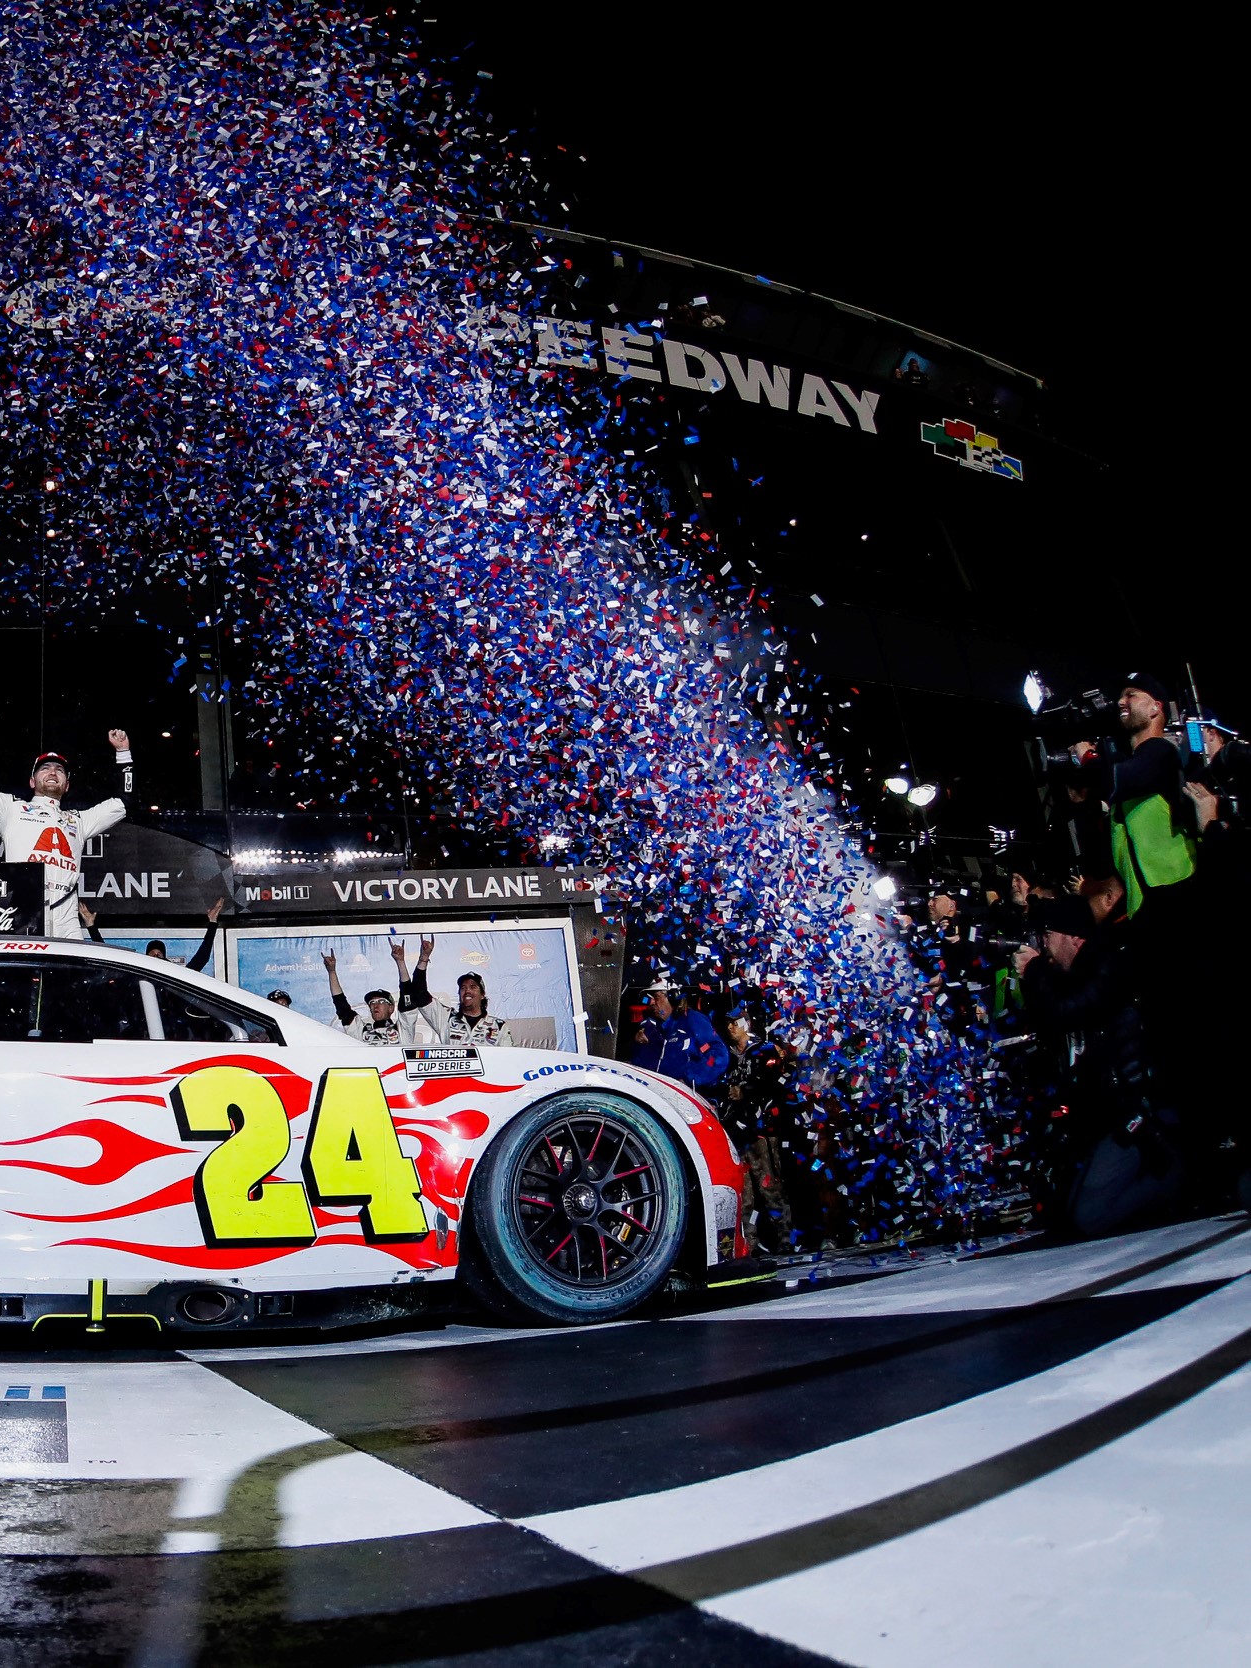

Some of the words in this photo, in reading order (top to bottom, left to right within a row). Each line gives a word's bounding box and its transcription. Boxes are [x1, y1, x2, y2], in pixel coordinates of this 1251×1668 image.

[463, 302, 881, 434] PEEDWAY
[77, 872, 171, 898] LANE
[245, 886, 291, 901] Mobil
[333, 877, 459, 902] VICTORY
[466, 875, 541, 899] LANE
[417, 1063, 437, 1072] CUP
[437, 1061, 471, 1071] SERIES
[428, 1050, 467, 1059] NASCAR
[523, 1064, 649, 1087] GOODYEAR
[169, 1065, 429, 1249] 24
